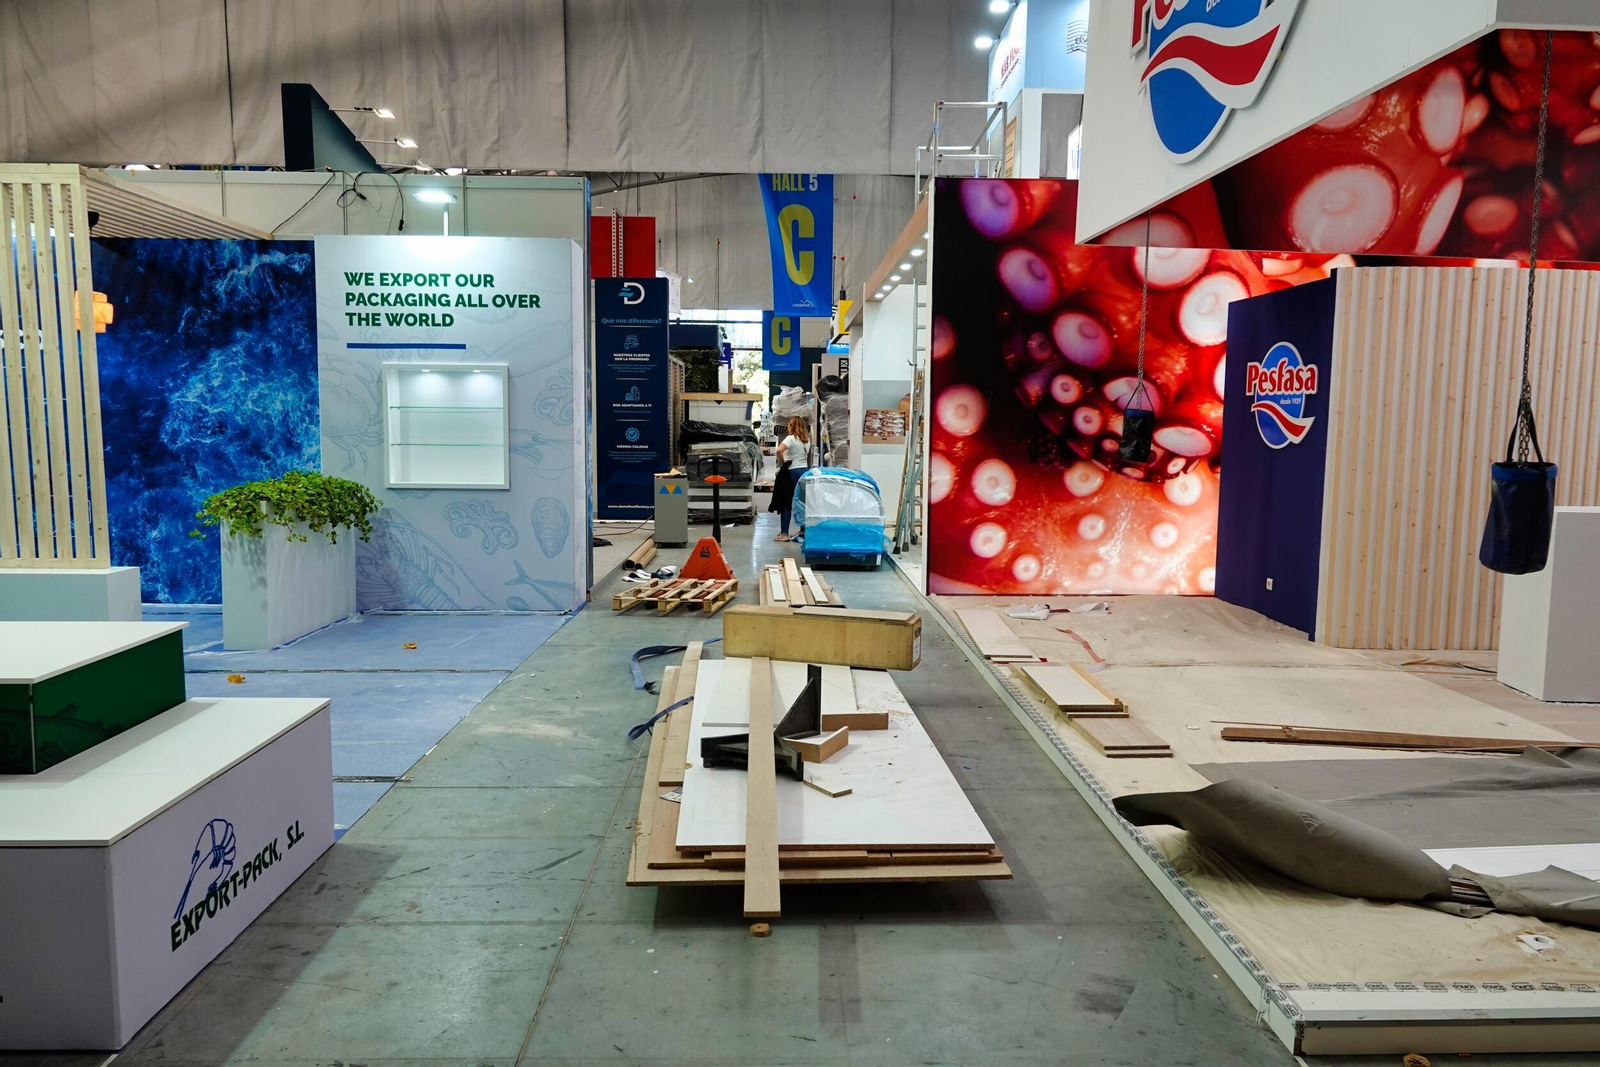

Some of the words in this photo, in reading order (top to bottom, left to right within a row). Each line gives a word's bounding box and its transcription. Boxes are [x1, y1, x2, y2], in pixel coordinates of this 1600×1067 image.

[772, 173, 805, 191] HALL
[809, 173, 818, 191] 5
[778, 204, 814, 285] C
[344, 271, 375, 287] WE
[379, 272, 451, 287] EXPORT
[455, 273, 495, 288] OUR
[345, 292, 451, 307] PACKAGING
[454, 293, 489, 308] ALL
[492, 294, 541, 308] OVER
[345, 312, 381, 327] THE
[385, 313, 454, 327] WORLD
[771, 316, 791, 355] C
[1246, 358, 1317, 395] Pesfasa
[1280, 397, 1292, 405] desde
[171, 837, 282, 952] EXPORT-PACK,
